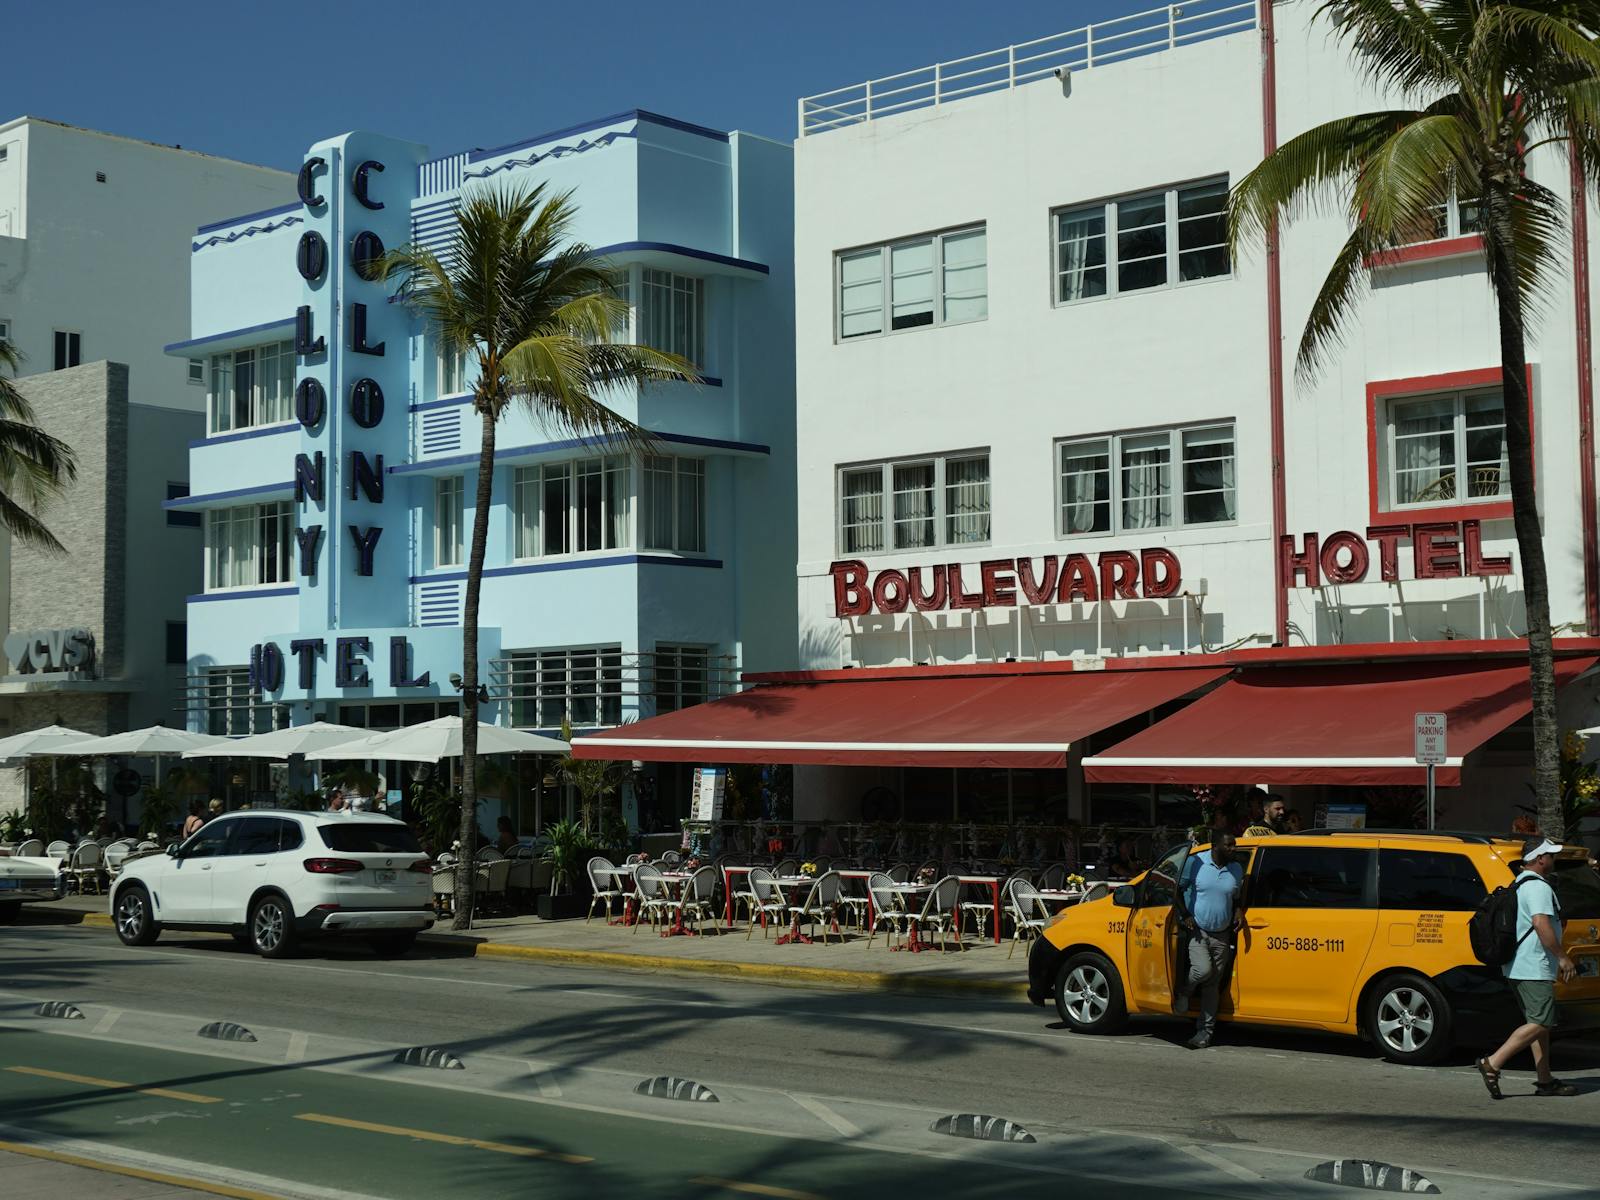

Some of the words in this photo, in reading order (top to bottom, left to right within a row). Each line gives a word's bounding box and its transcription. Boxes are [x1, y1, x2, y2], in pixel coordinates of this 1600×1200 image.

[295, 156, 325, 576] COLONY
[348, 160, 385, 577] COLONY
[830, 547, 1182, 618] BOULEVARD
[1279, 519, 1512, 588] HOTEL
[29, 627, 92, 670] CVS
[1418, 726, 1444, 736] PARKING
[1424, 716, 1437, 725] NO
[1108, 921, 1125, 933] 3132
[1267, 936, 1345, 953] 305-888-1111
